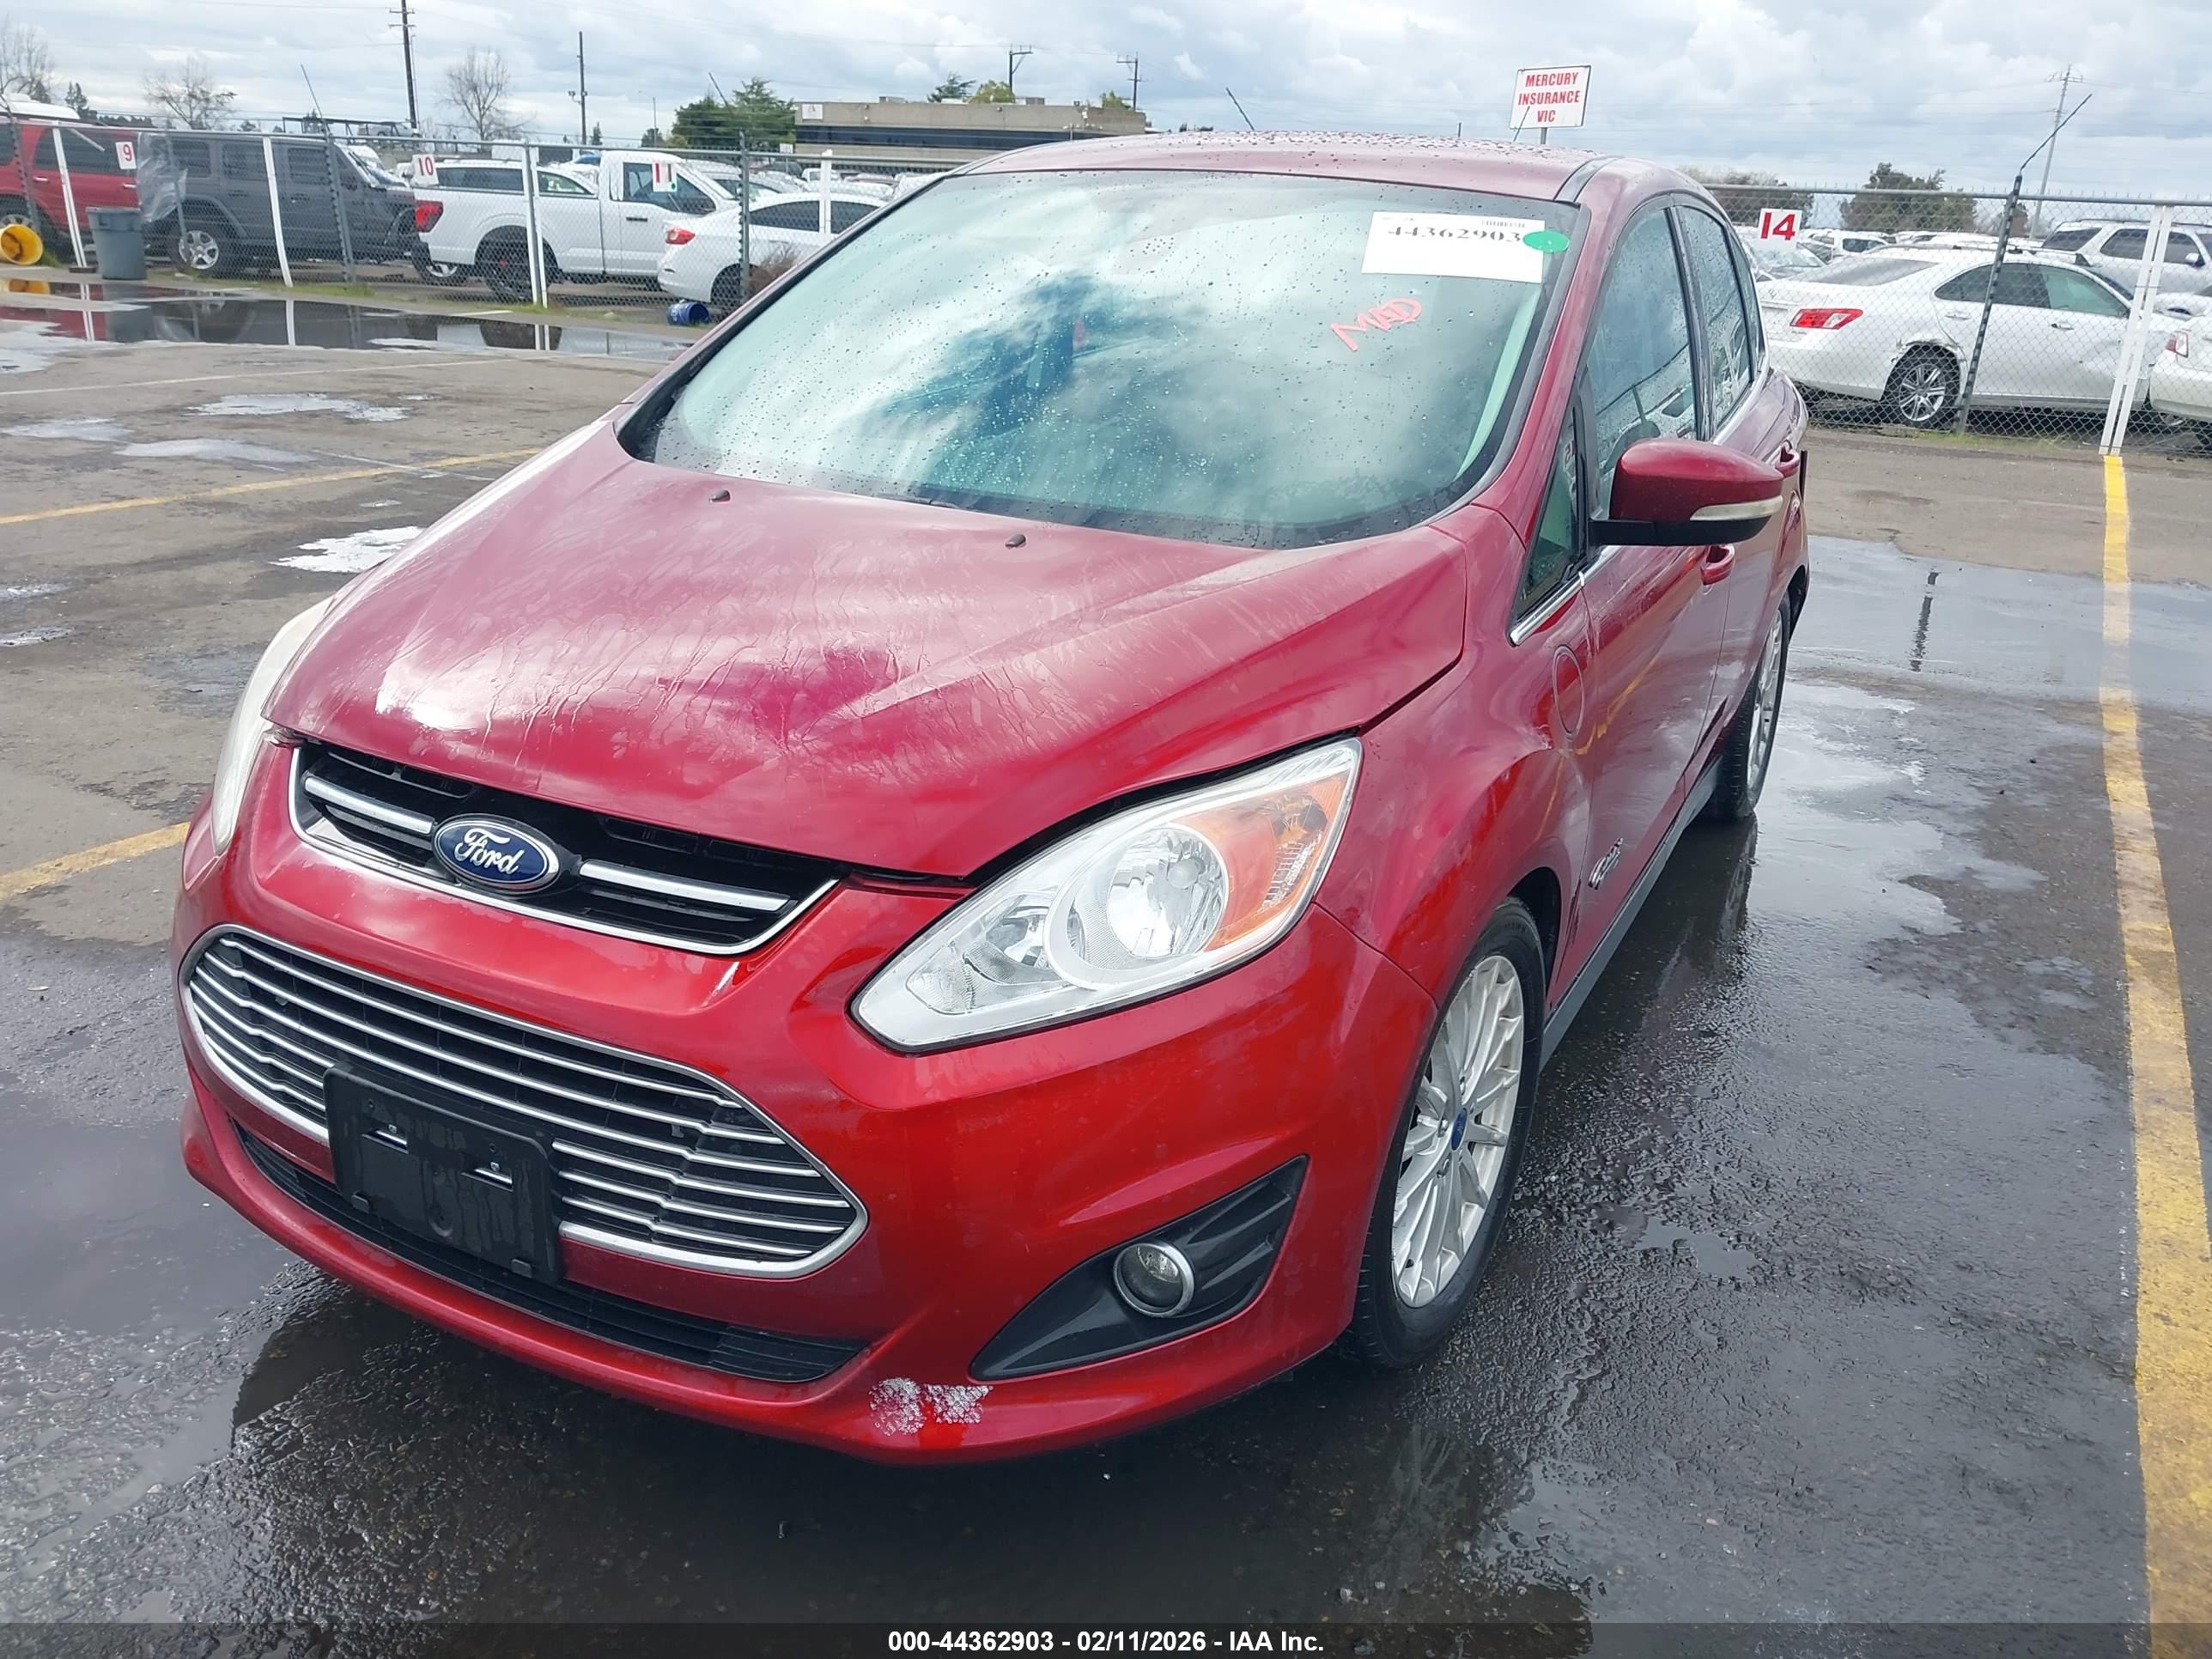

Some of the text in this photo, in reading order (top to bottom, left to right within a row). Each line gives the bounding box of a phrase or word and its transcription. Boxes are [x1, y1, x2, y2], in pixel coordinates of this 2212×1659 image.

[1525, 72, 1579, 88] MERCURY
[1518, 90, 1581, 106] INSURANCE
[1537, 109, 1556, 123] VIC
[123, 143, 133, 162] 9
[417, 156, 434, 177] 10
[655, 162, 672, 184] 11
[1388, 225, 1522, 243] 44362903
[1759, 211, 1796, 241] 14
[453, 827, 526, 875] Ford
